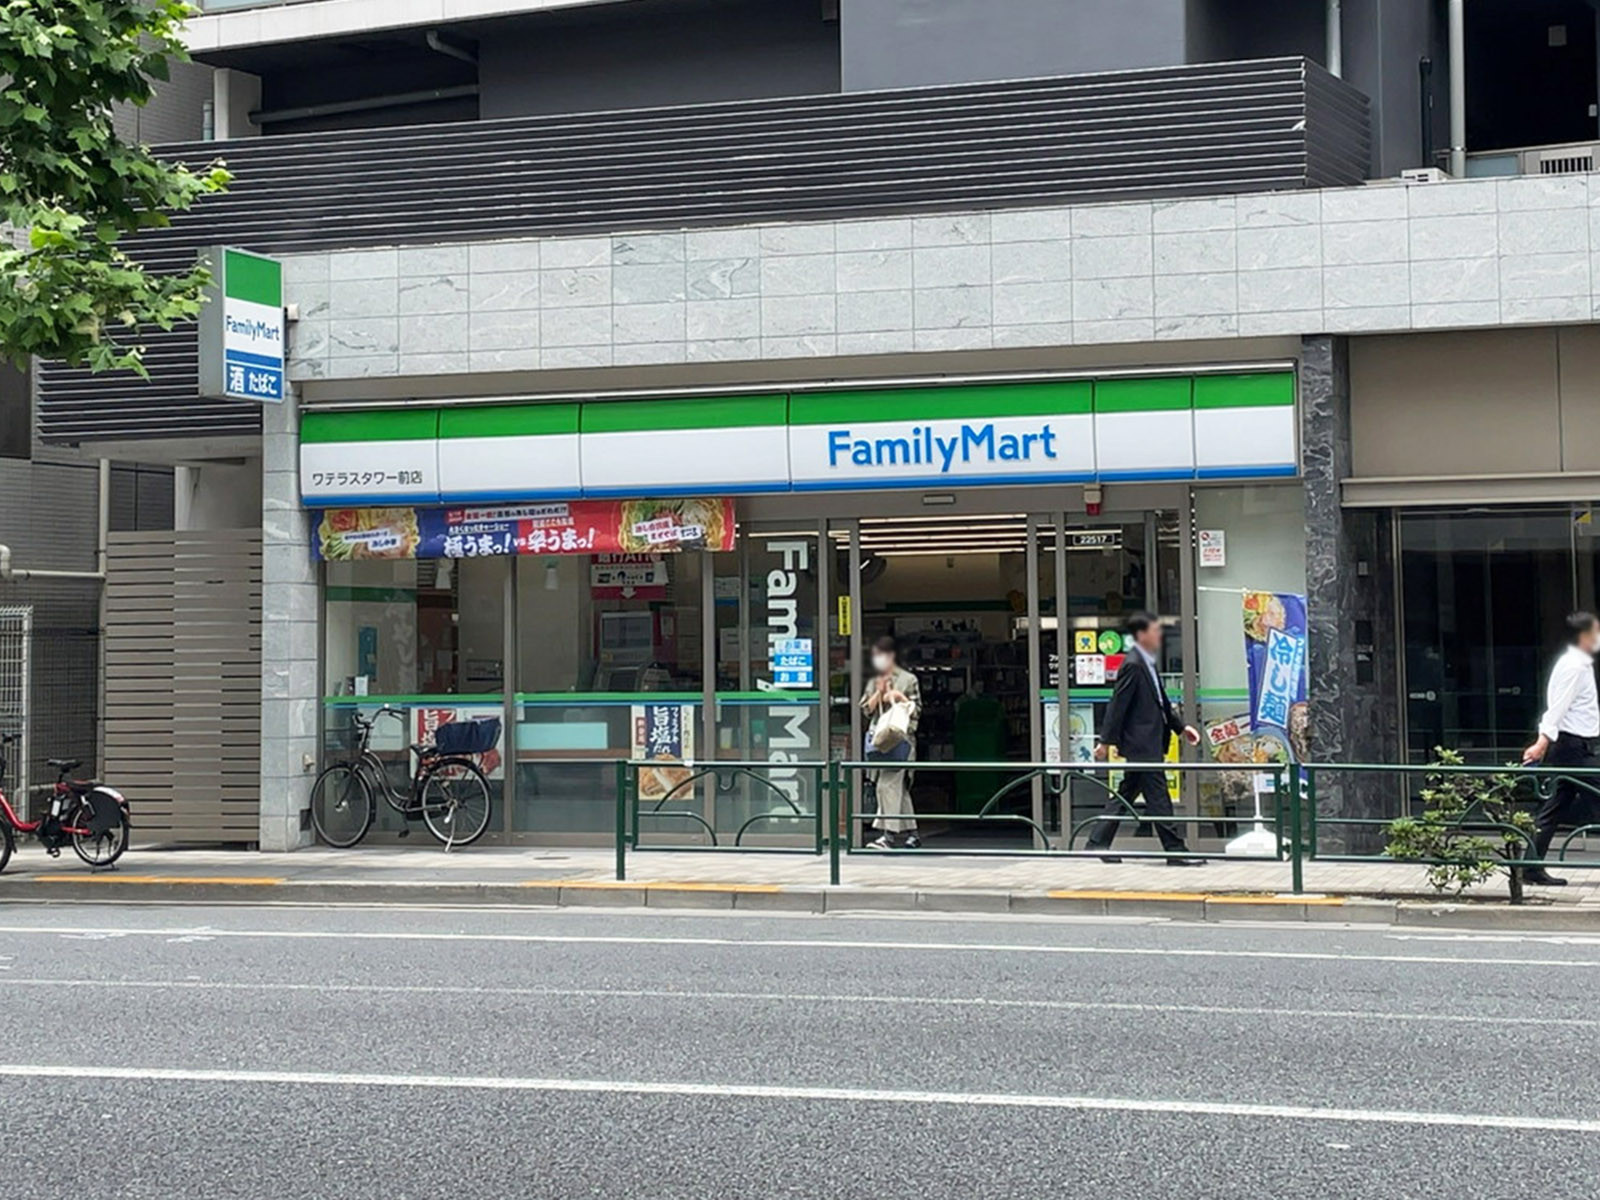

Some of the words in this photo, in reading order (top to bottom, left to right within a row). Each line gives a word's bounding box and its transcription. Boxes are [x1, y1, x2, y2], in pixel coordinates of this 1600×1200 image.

[226, 314, 280, 341] FamilyMart
[230, 366, 245, 392] 酒
[248, 372, 278, 395] たばこ
[828, 424, 1057, 473] FamilyMart
[312, 470, 423, 486] ワテラスタワー前店
[1080, 535, 1107, 544] 22517
[780, 656, 807, 666] たばこ
[1260, 631, 1297, 726] 冷し麺
